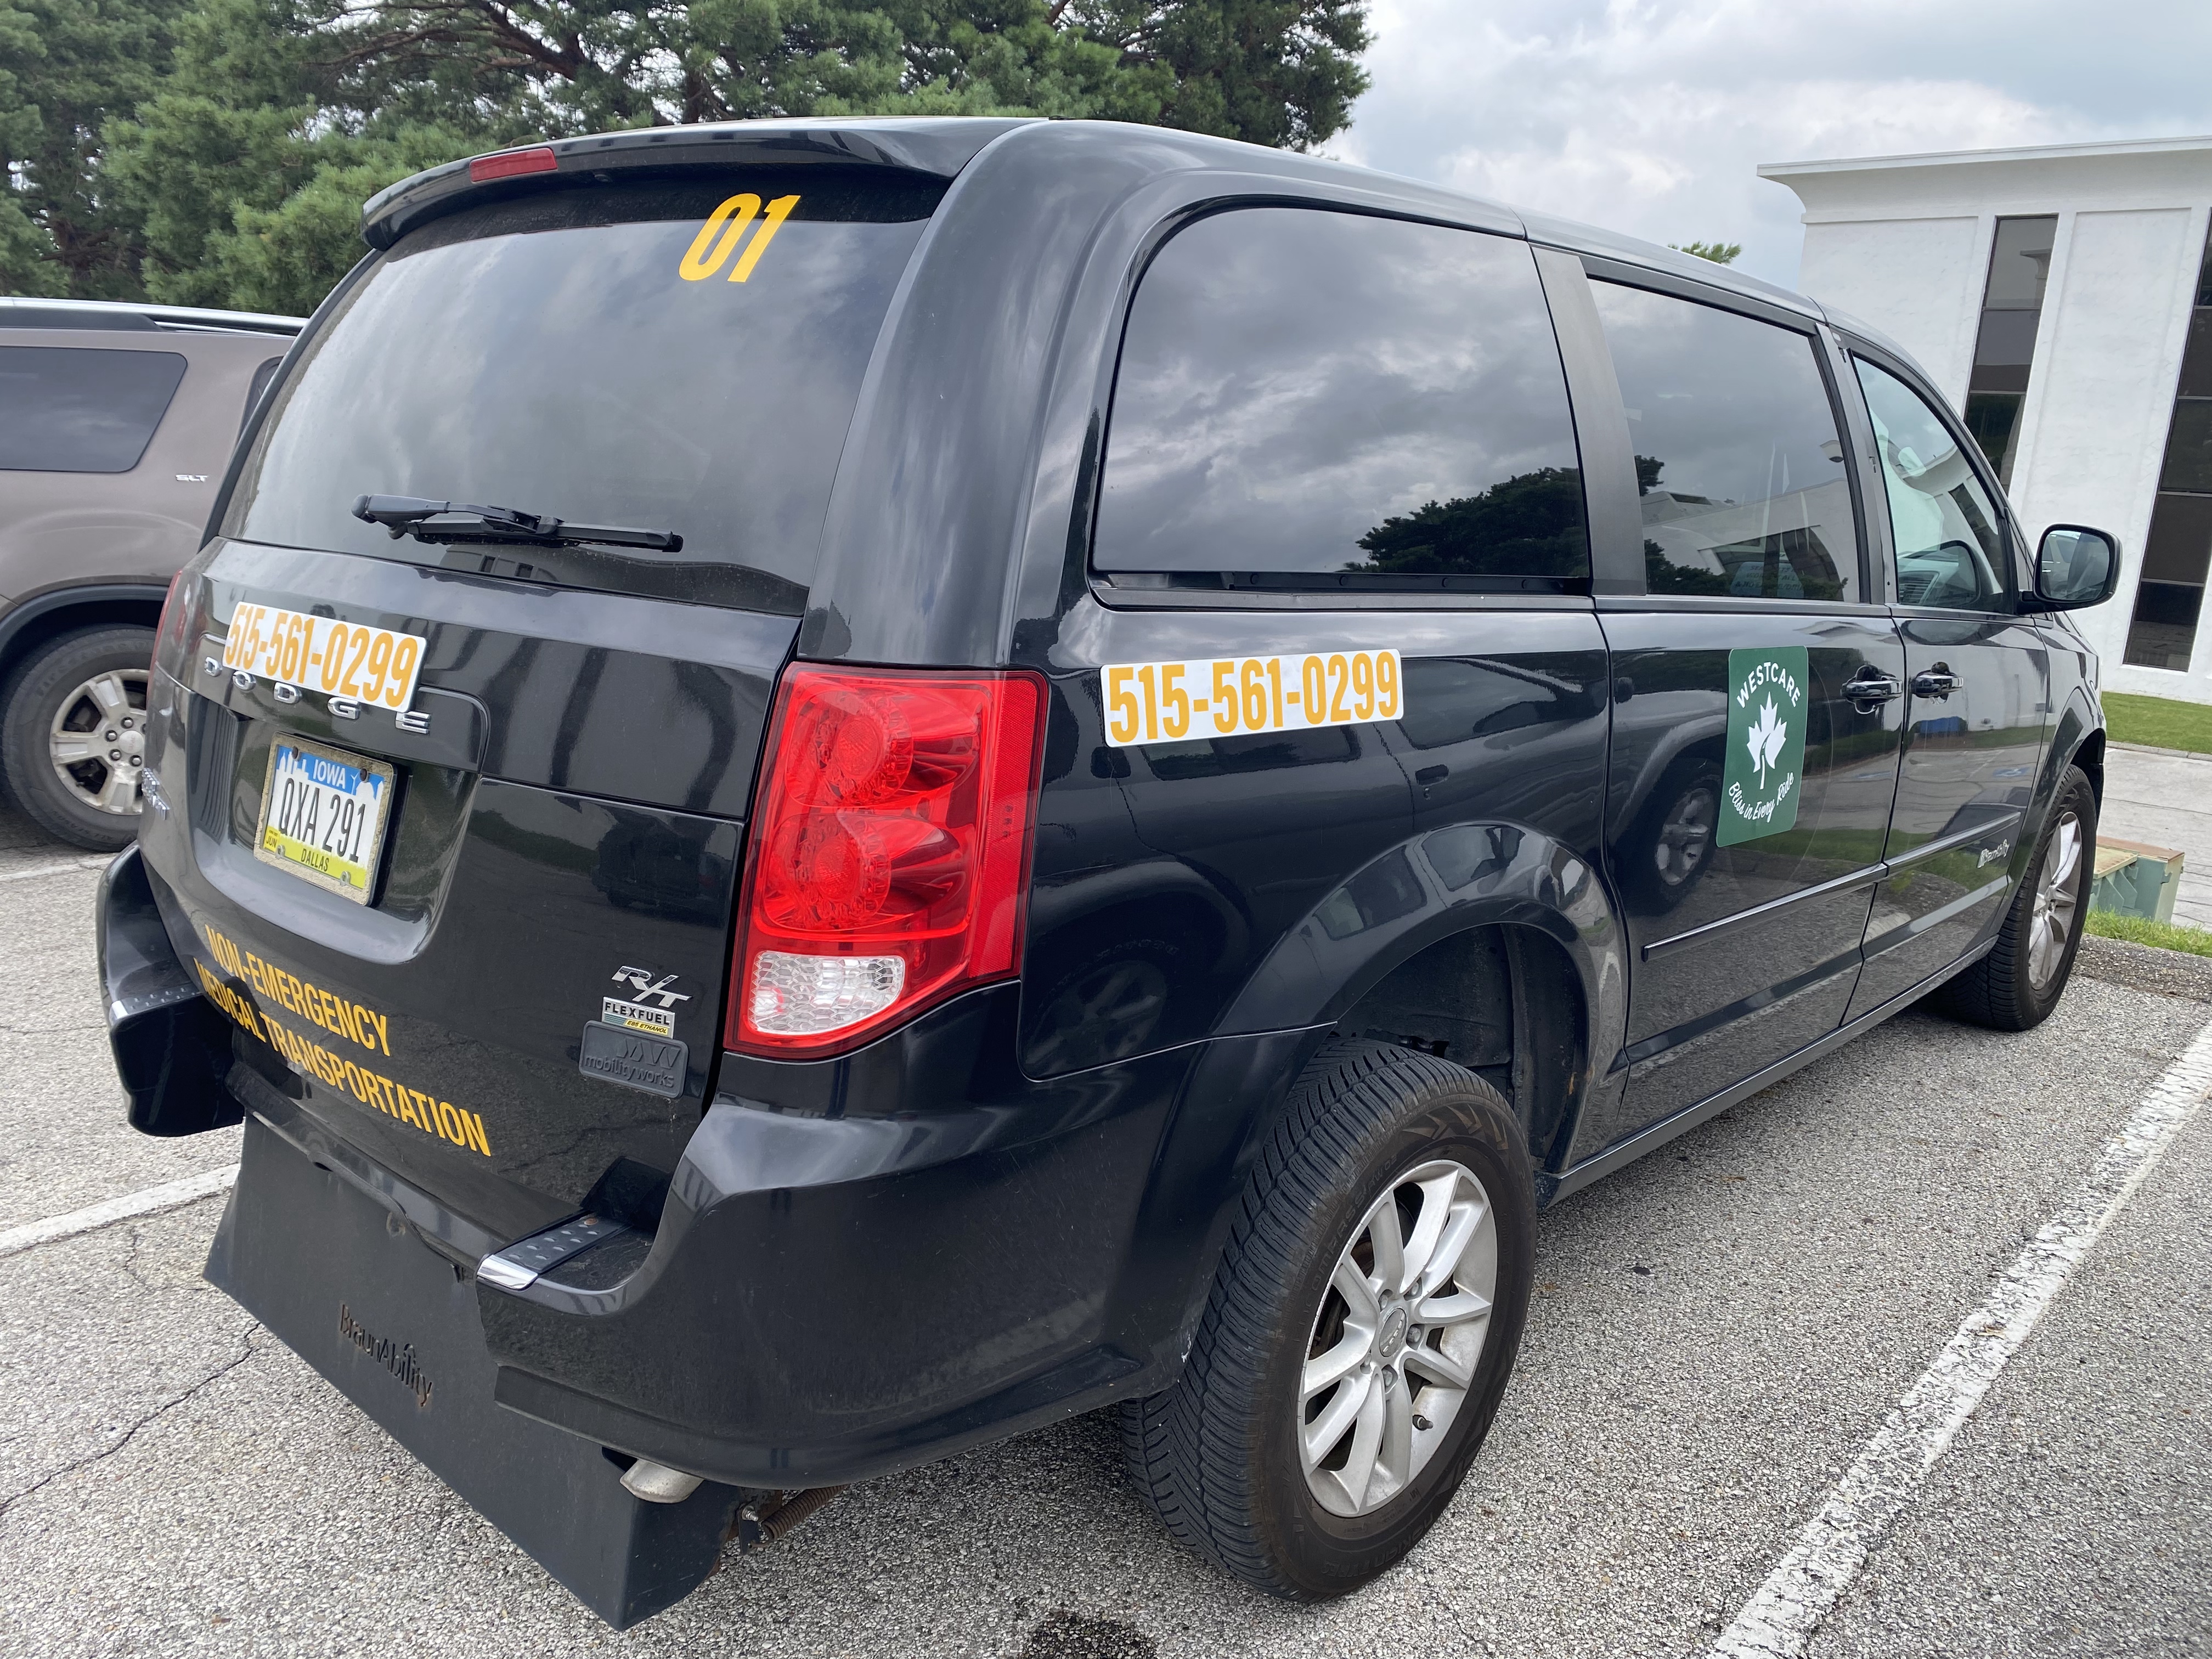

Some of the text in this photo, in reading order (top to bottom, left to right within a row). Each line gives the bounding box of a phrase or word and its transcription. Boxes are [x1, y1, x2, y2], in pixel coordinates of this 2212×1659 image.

[679, 193, 801, 283] 01
[175, 474, 208, 482] SLT
[224, 605, 418, 708] 515-561-0299
[1736, 662, 1801, 708] WESTCARE
[204, 656, 431, 734] DODGE
[1109, 651, 1398, 743] 515-561-0299
[313, 759, 346, 789] IOWA
[1729, 772, 1794, 823] Bliss in Every Ride
[266, 836, 277, 848] JUN
[278, 777, 366, 863] QXA 291
[301, 849, 329, 872] DALLAS
[205, 924, 390, 1056] NON-EMERGENCY
[605, 1002, 669, 1025] FLEXFUEL
[193, 957, 491, 1156] MEDICAL TRANSPORTATION
[640, 1024, 667, 1034] ETHANOL
[340, 1304, 432, 1407] BraunAbility
